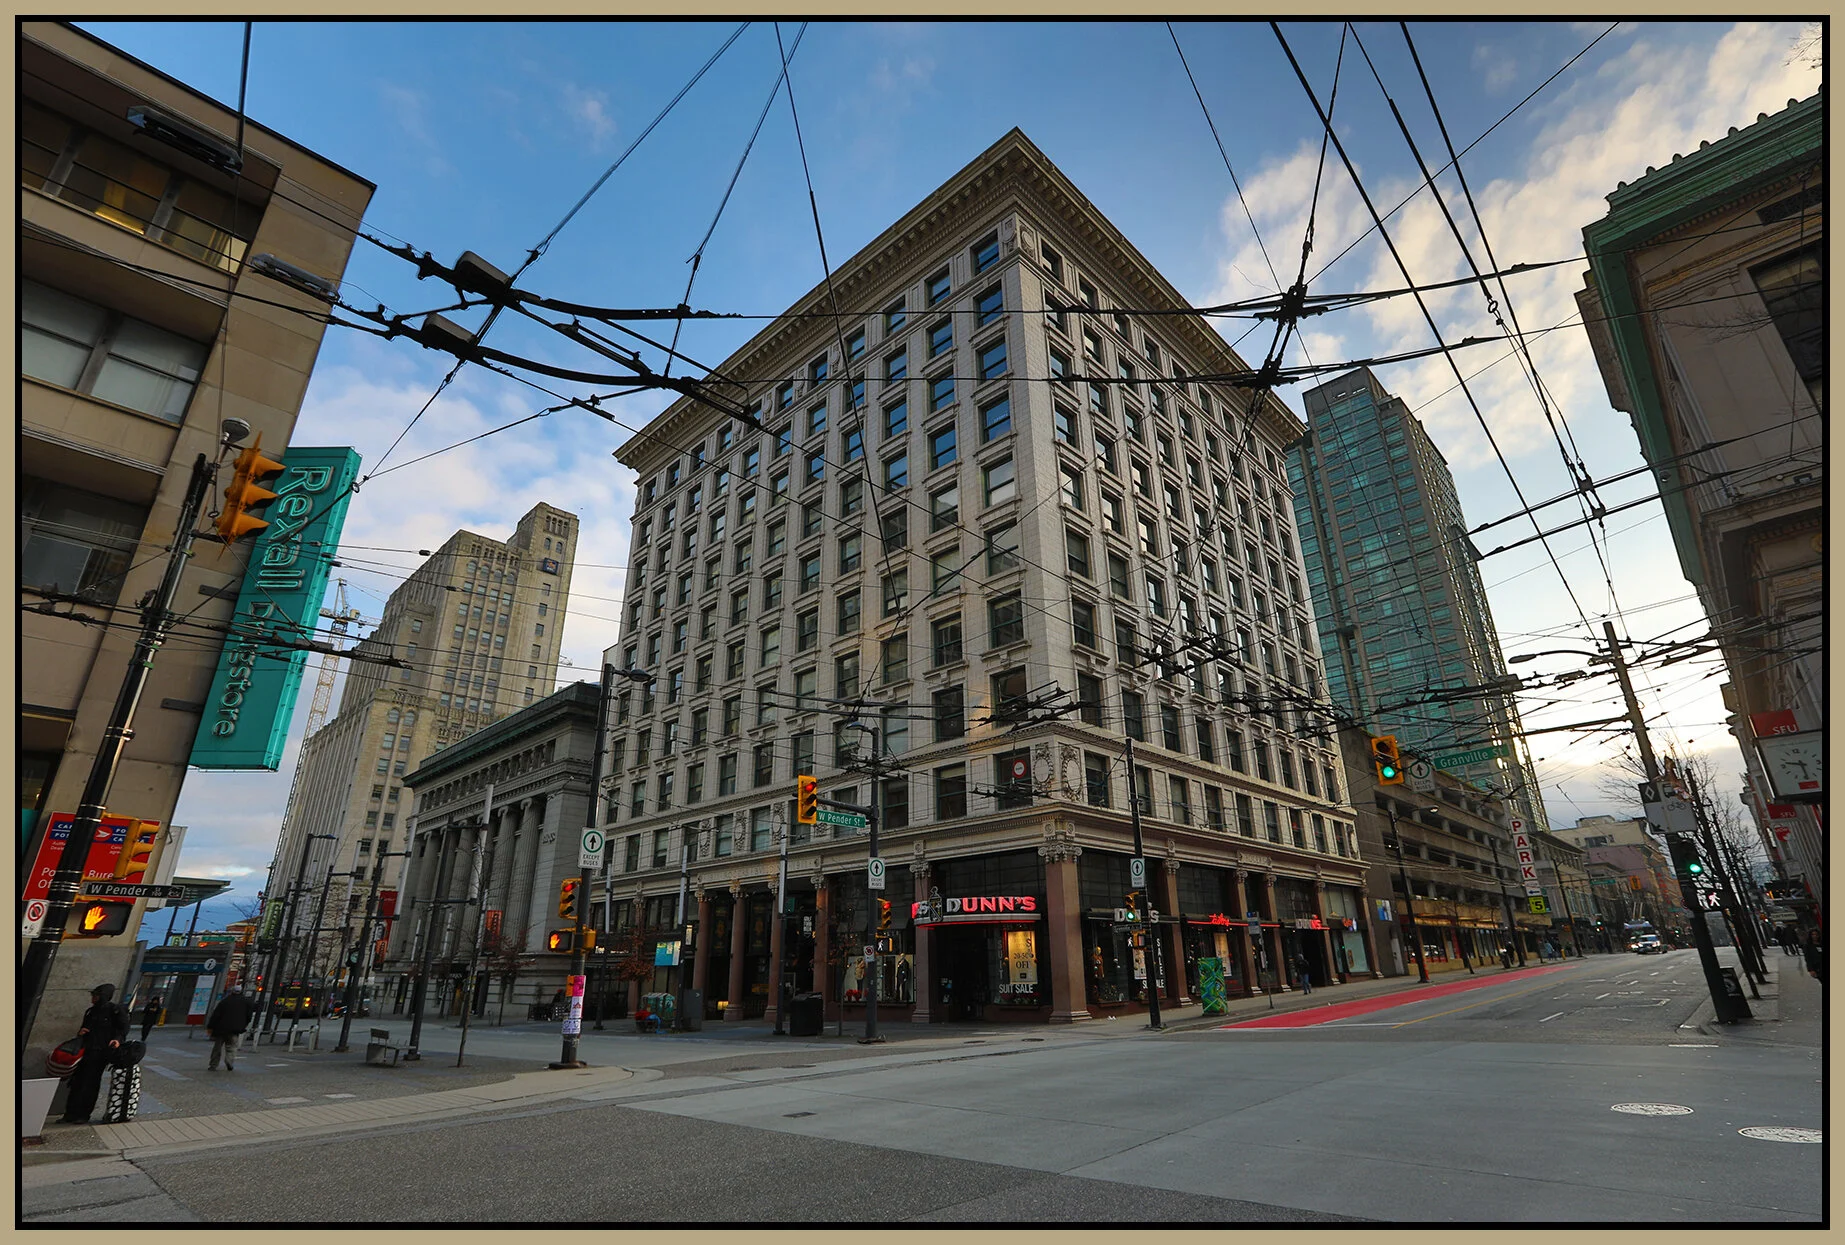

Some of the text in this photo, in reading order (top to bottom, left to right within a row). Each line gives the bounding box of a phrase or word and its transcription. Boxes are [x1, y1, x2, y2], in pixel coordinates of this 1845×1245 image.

[256, 465, 335, 591] Rexall
[1772, 723, 1798, 736] SFU
[1440, 746, 1504, 769] Granville St
[818, 812, 861, 826] W Pender St
[1511, 820, 1537, 880] PARK
[91, 884, 149, 897] W Pender
[946, 895, 1037, 913] DUNN'S
[1156, 938, 1164, 976] SALE
[999, 983, 1034, 994] SUIT SALE
